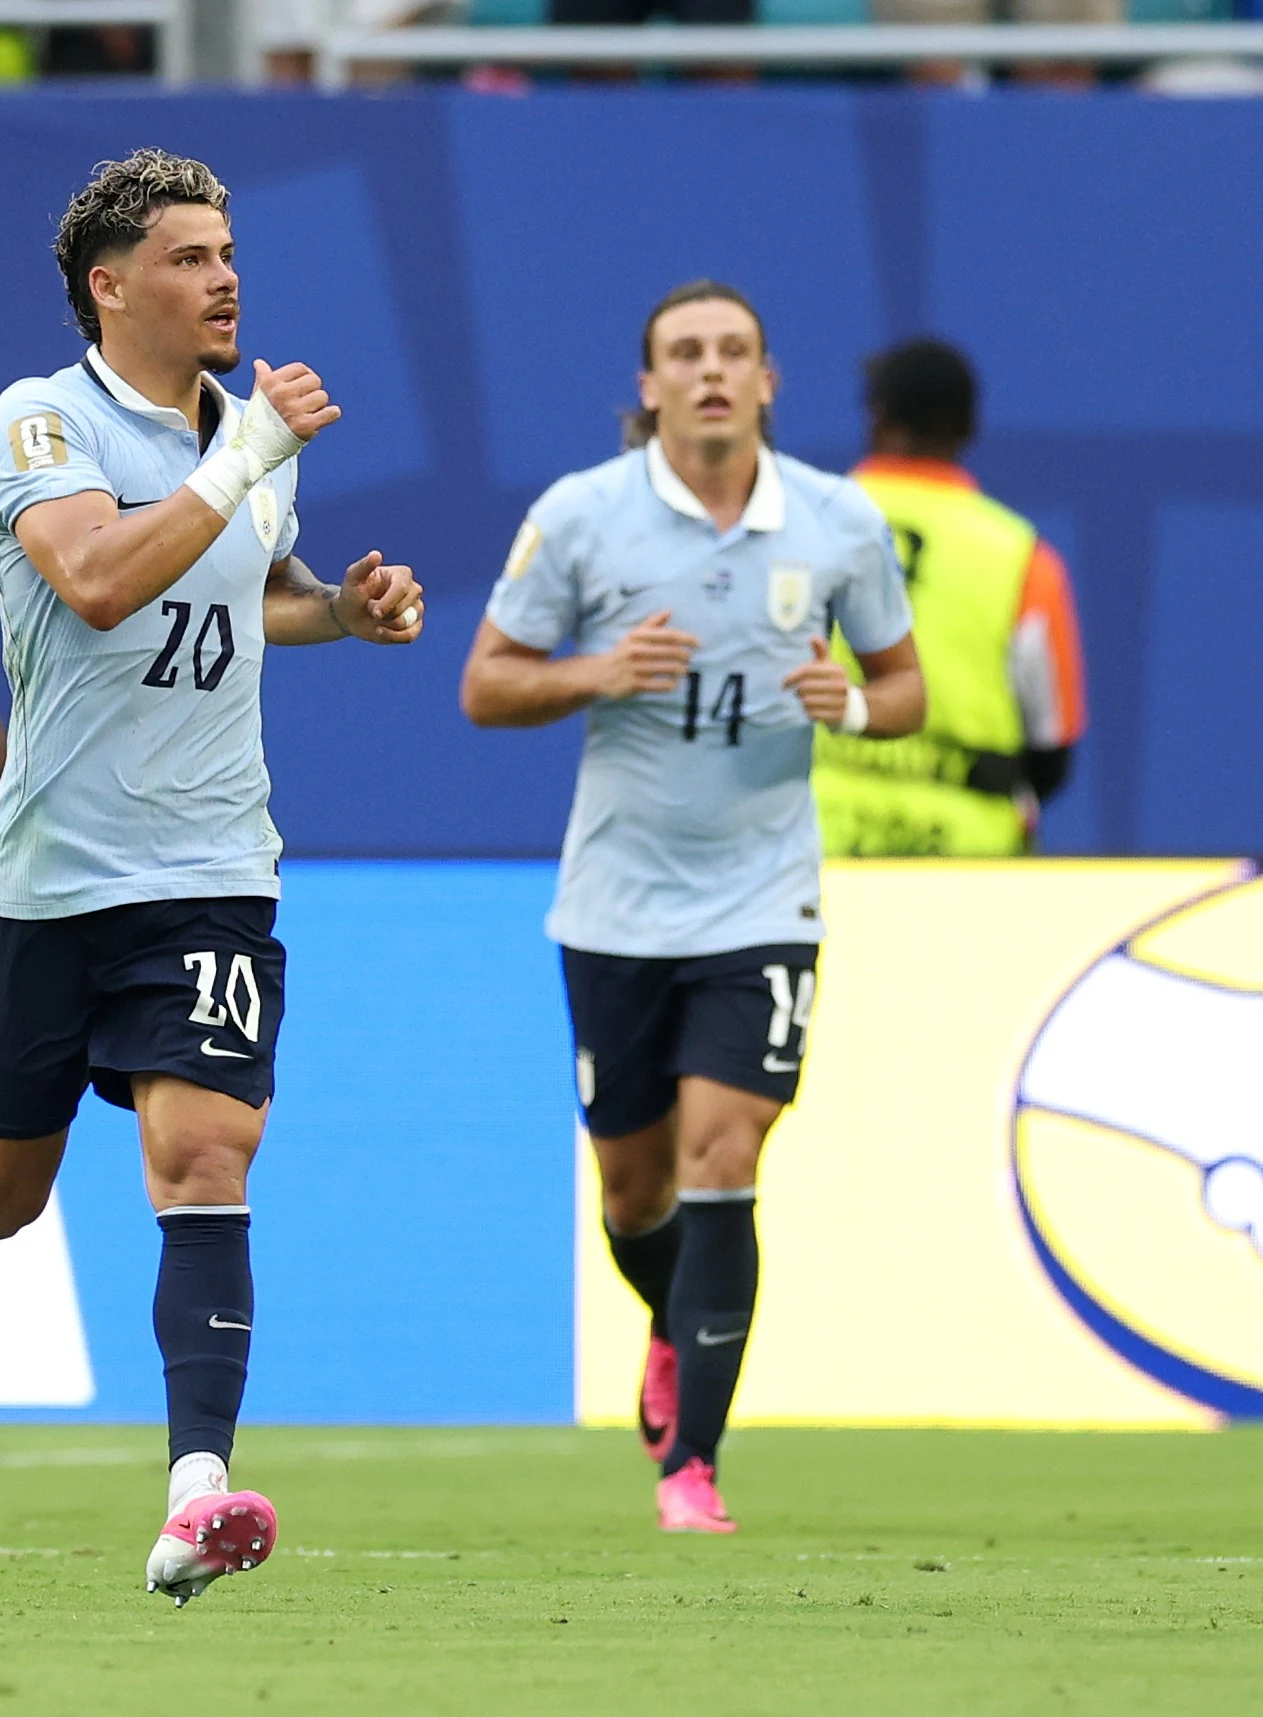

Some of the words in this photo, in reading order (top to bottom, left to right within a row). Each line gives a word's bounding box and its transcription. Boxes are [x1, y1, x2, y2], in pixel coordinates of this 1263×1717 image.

[141, 600, 235, 692] 20
[682, 672, 744, 747] 14
[183, 951, 262, 1043] 20
